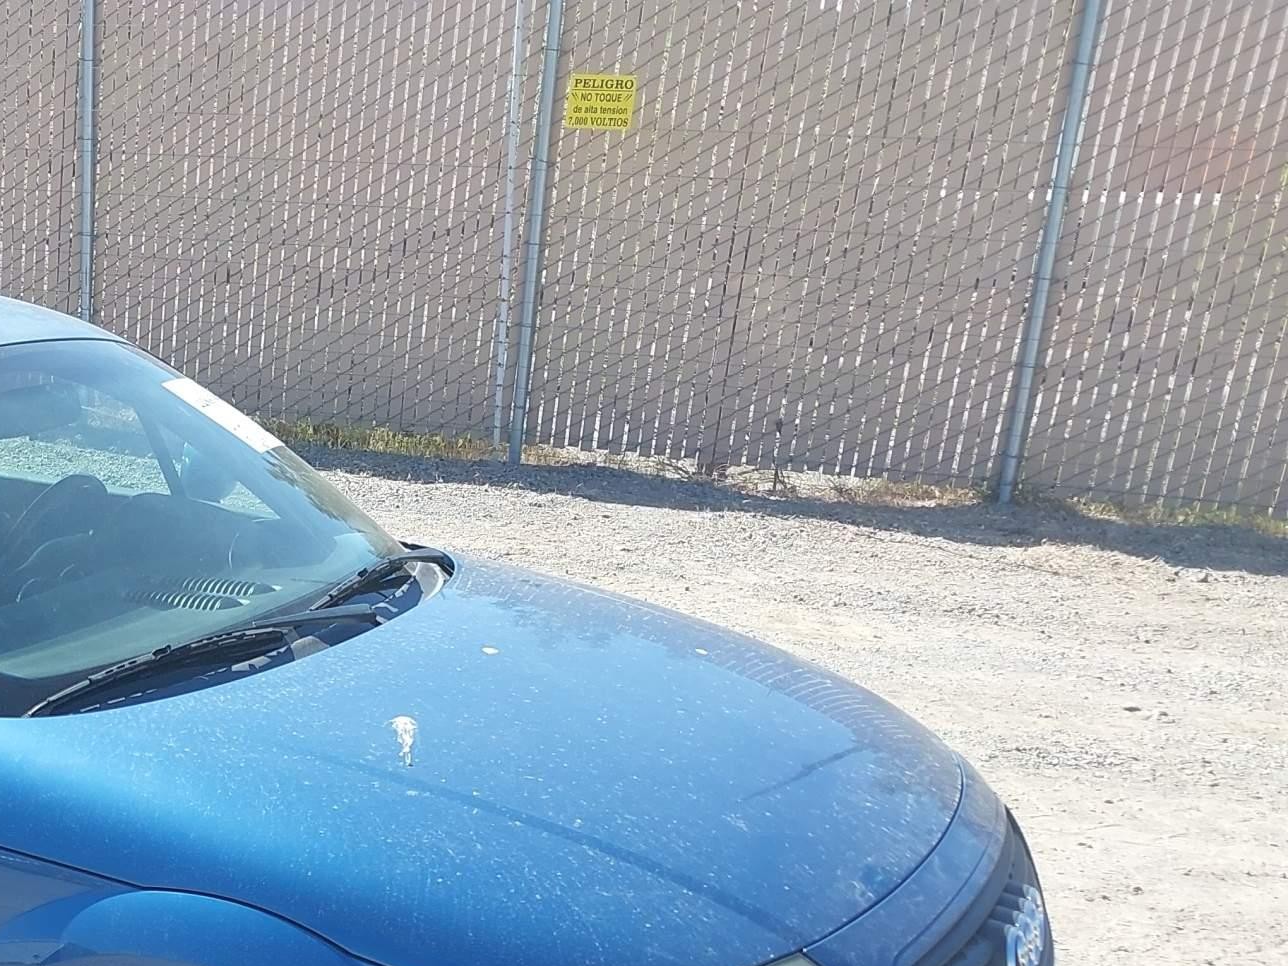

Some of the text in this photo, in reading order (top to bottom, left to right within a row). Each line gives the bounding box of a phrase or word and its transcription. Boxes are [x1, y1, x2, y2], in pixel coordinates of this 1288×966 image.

[574, 78, 634, 89] PELIGRO
[580, 92, 622, 102] NO TOQUE
[573, 105, 628, 115] de alta tension
[568, 116, 629, 127] 7,000 VOLTIOS
